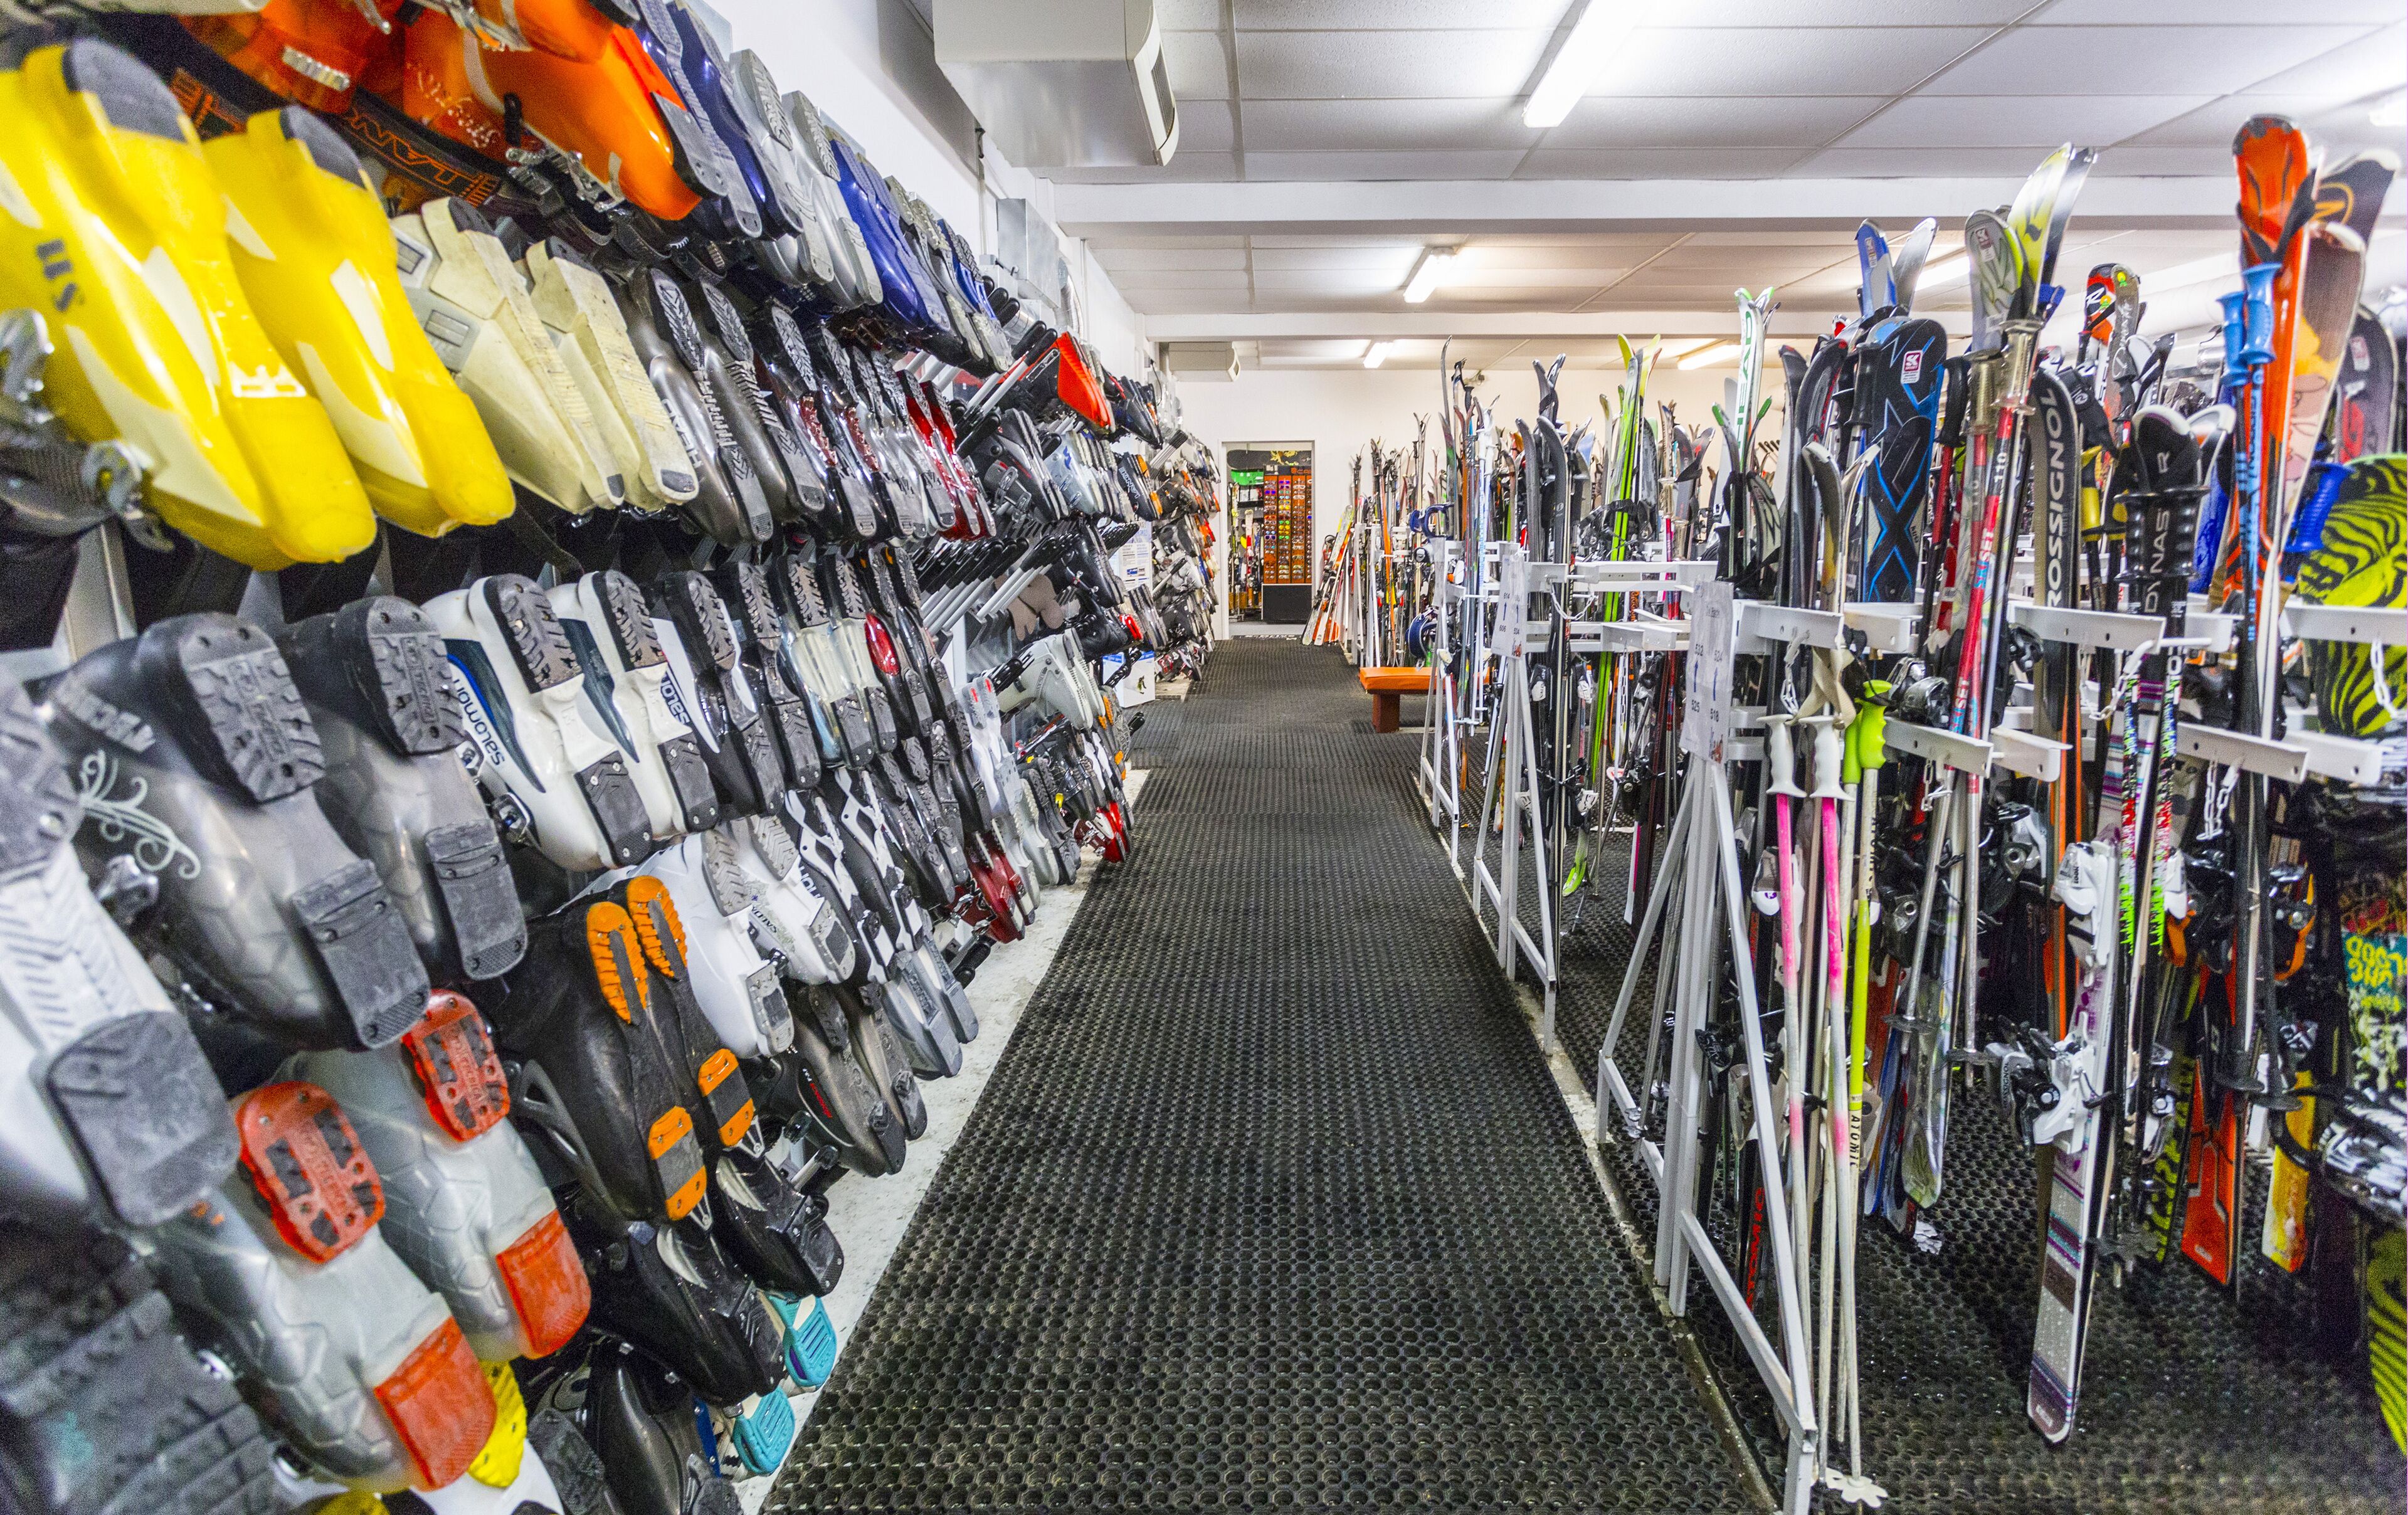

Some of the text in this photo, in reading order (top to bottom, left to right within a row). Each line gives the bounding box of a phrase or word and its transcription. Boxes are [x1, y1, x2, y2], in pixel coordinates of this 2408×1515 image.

[1735, 310, 1753, 447] HEAD
[1119, 467, 1138, 500] LANGE
[1995, 452, 2008, 483] 110
[2039, 387, 2064, 607] ROSSIGNOL
[1975, 532, 1993, 588] SKISET
[2143, 451, 2170, 613] DYNASR
[1850, 1116, 1860, 1168] ATOMIC
